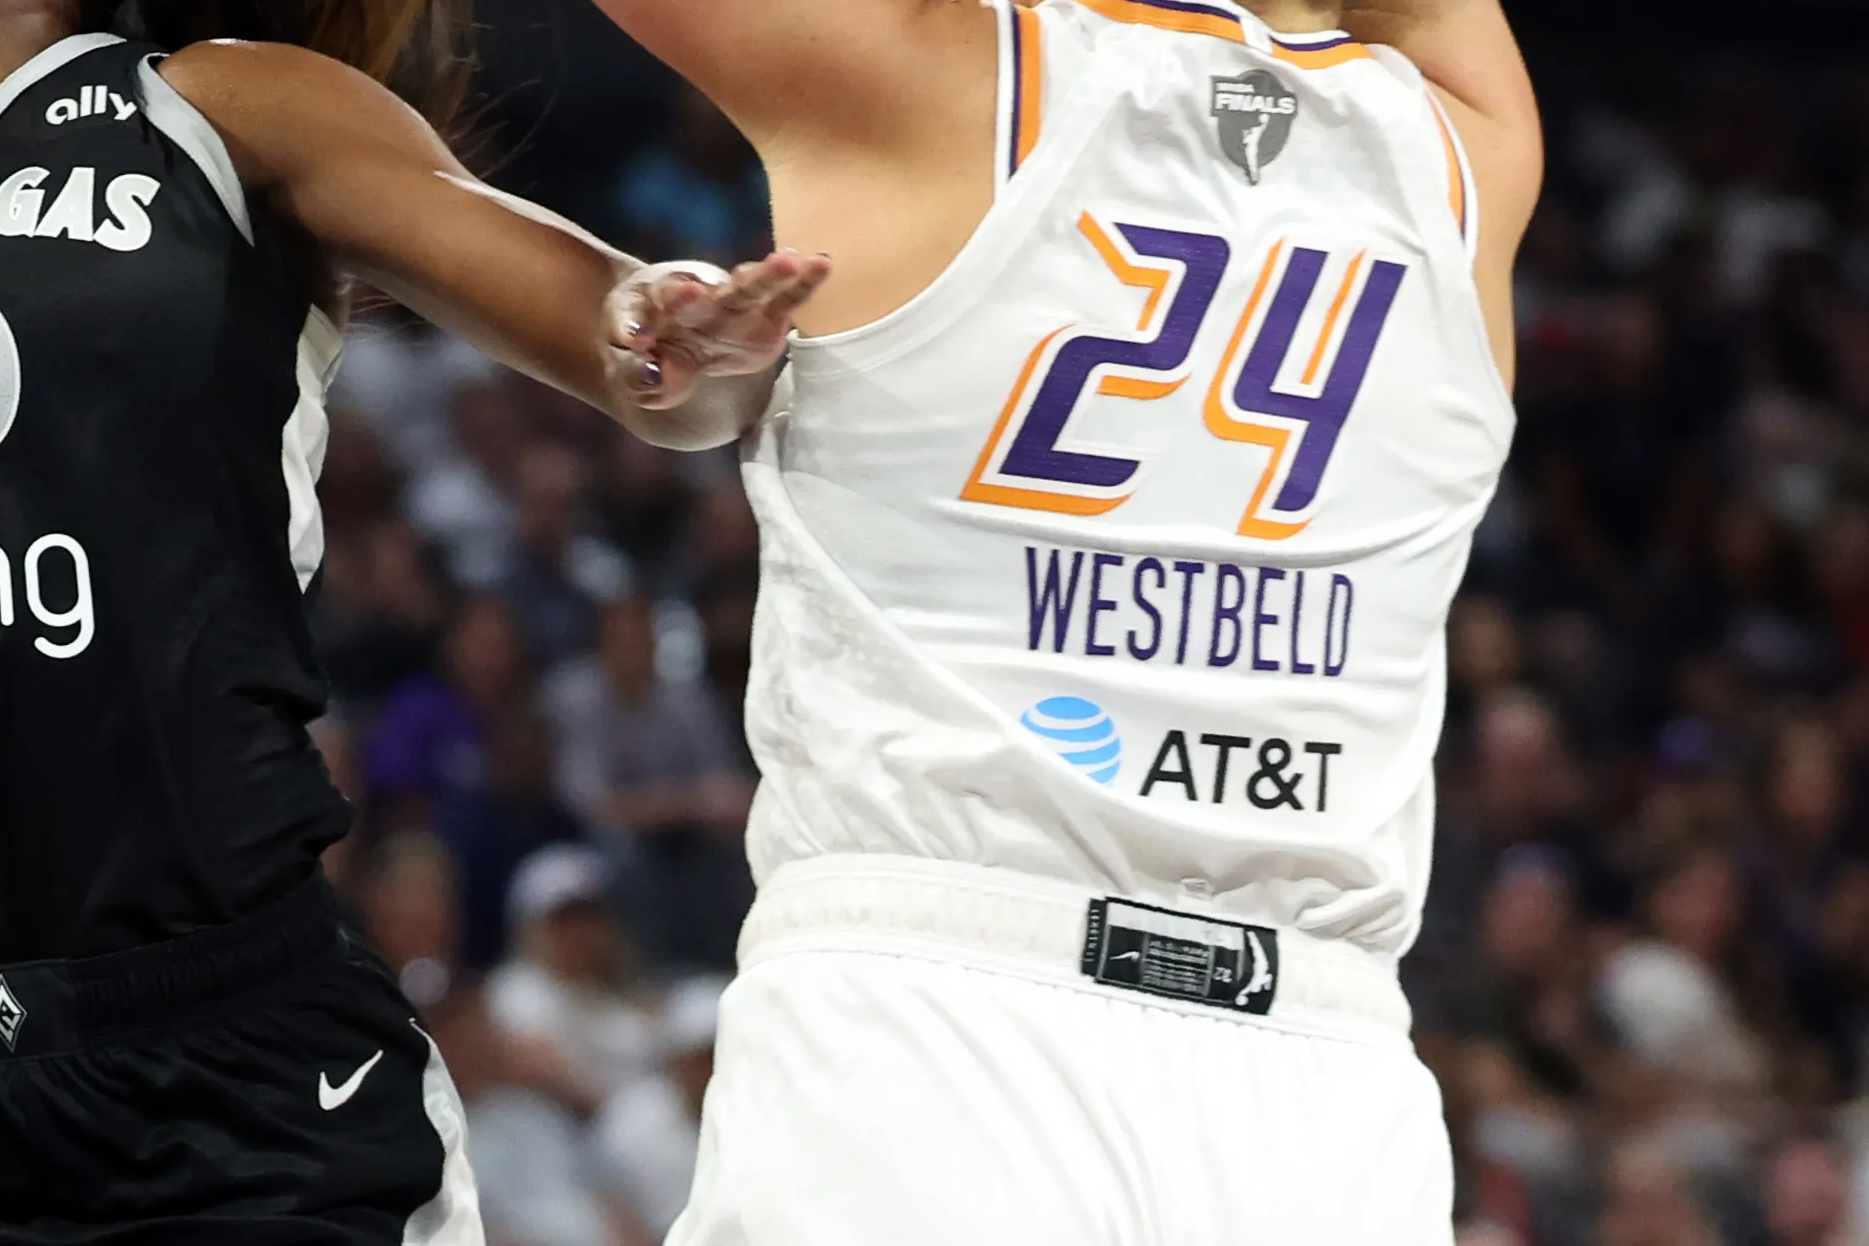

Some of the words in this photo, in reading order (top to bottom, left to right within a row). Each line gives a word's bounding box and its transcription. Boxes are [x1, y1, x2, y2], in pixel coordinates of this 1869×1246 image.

[45, 85, 137, 125] ally
[1215, 93, 1296, 114] FINALS
[958, 210, 1408, 540] 24
[1024, 546, 1354, 676] WESTBELD
[1139, 730, 1343, 812] AT&T
